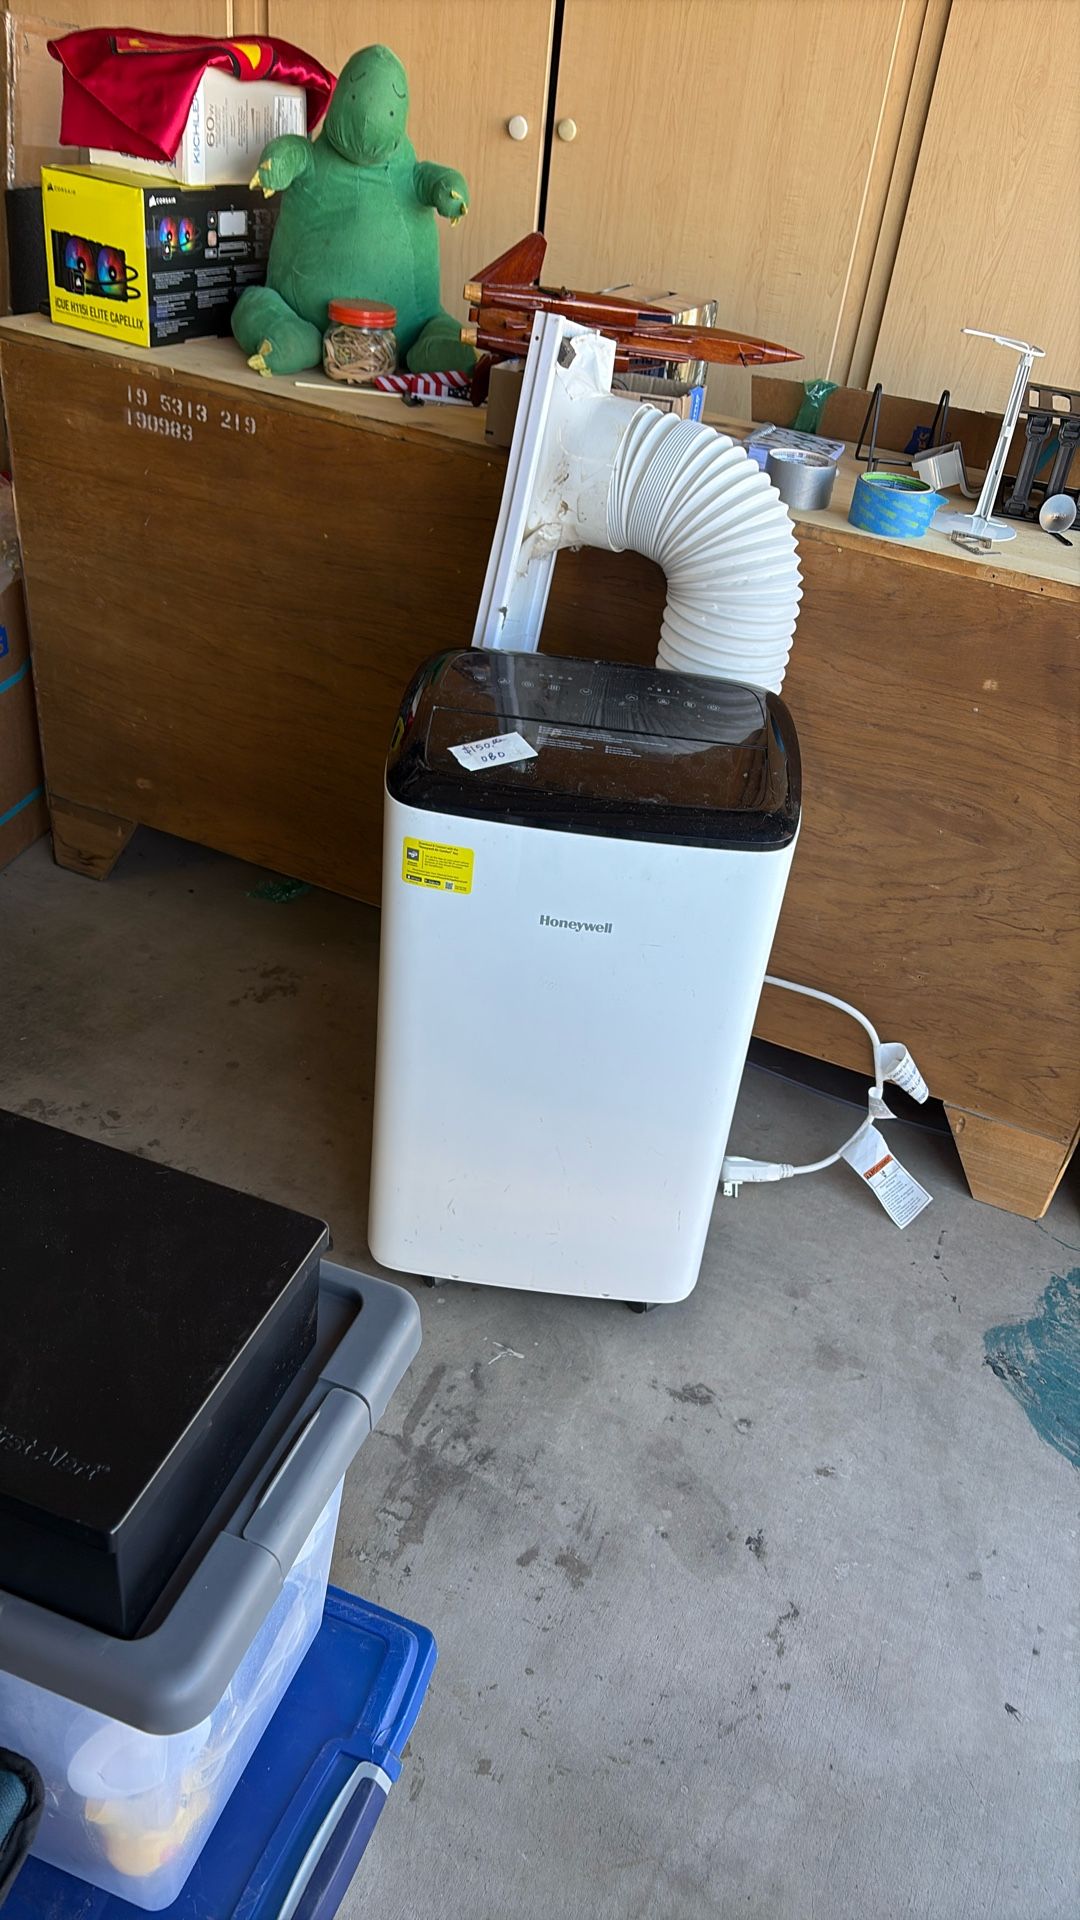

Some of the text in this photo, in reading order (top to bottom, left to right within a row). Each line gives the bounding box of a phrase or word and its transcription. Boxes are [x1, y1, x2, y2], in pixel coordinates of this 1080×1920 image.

[55, 296, 69, 311] iCUE
[70, 299, 89, 316] H115i
[89, 304, 109, 322] ELITE
[109, 310, 145, 331] CAPELLIX
[127, 384, 257, 435] 19 5313 219
[127, 407, 193, 442] 190983
[480, 751, 506, 763] OBO
[539, 914, 613, 933] Honeywell
